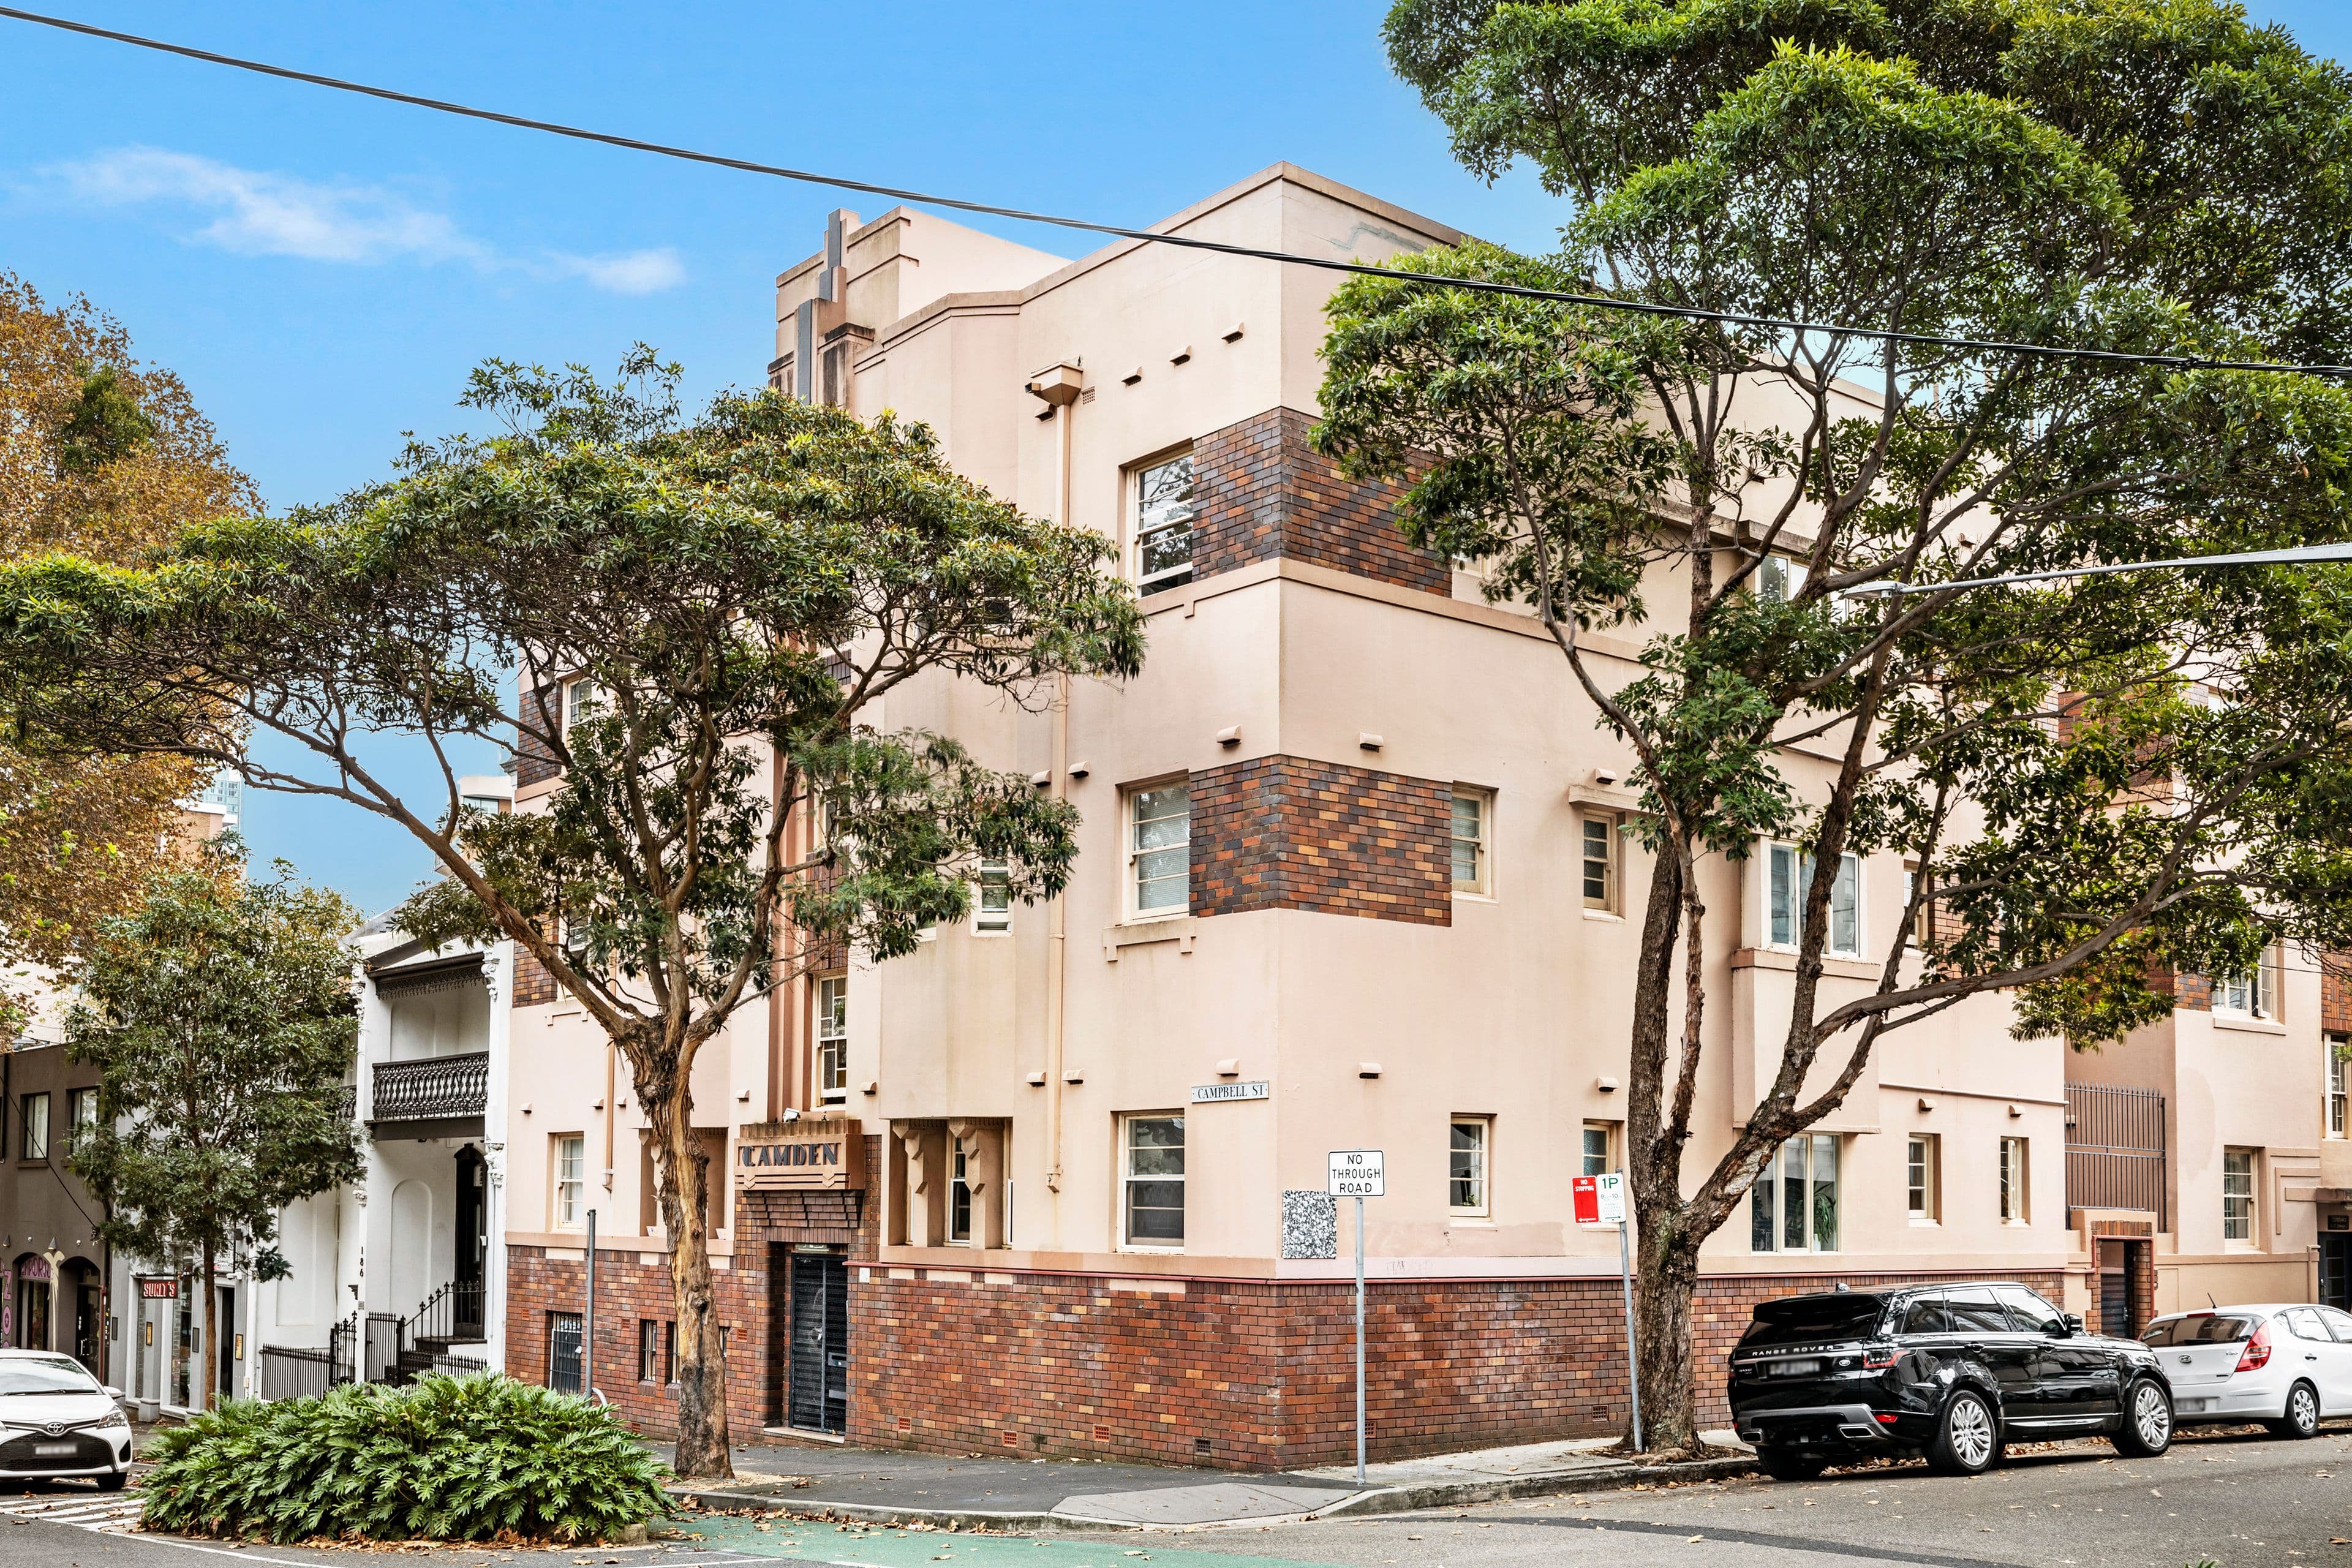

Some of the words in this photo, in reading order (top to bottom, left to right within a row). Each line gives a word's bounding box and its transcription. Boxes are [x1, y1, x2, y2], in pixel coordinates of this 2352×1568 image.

[1197, 1085, 1247, 1099] CAMPBELL
[1252, 1084, 1264, 1096] ST
[742, 1143, 839, 1167] CAMDEN
[1348, 1155, 1363, 1164] NO
[1332, 1169, 1381, 1179] THROUGH
[1340, 1183, 1372, 1193] ROAD
[1602, 1178, 1618, 1189] 1P
